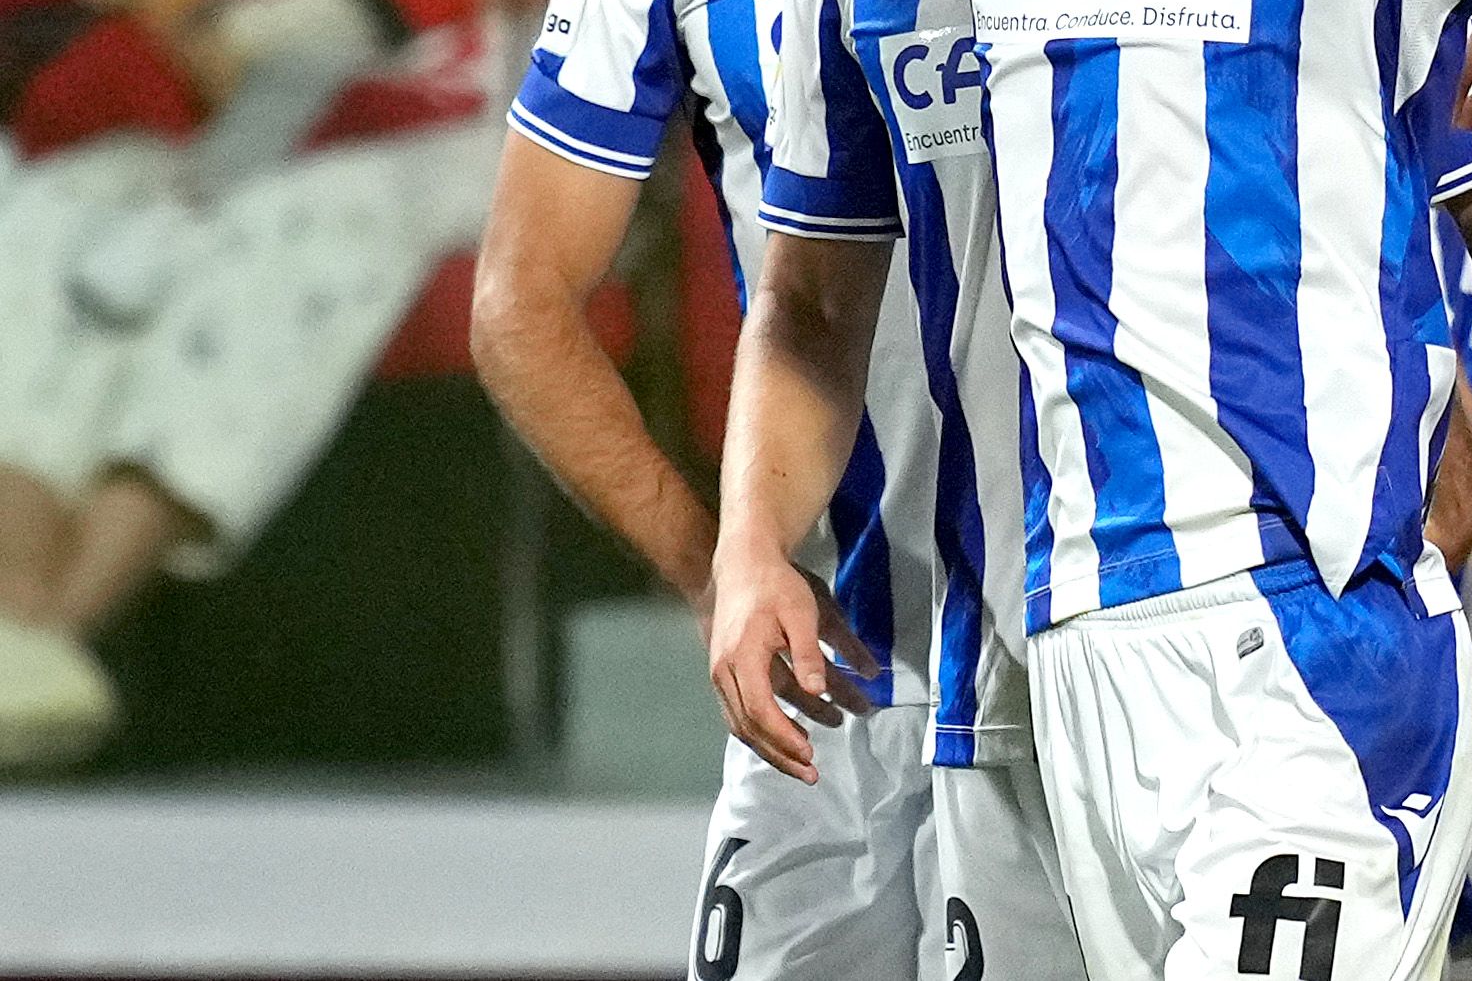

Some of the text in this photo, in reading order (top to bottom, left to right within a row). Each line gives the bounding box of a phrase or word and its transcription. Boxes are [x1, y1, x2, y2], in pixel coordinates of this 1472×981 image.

[976, 6, 1241, 32] Encuentra. Conduce. Disfruta.
[1229, 854, 1345, 981] fi
